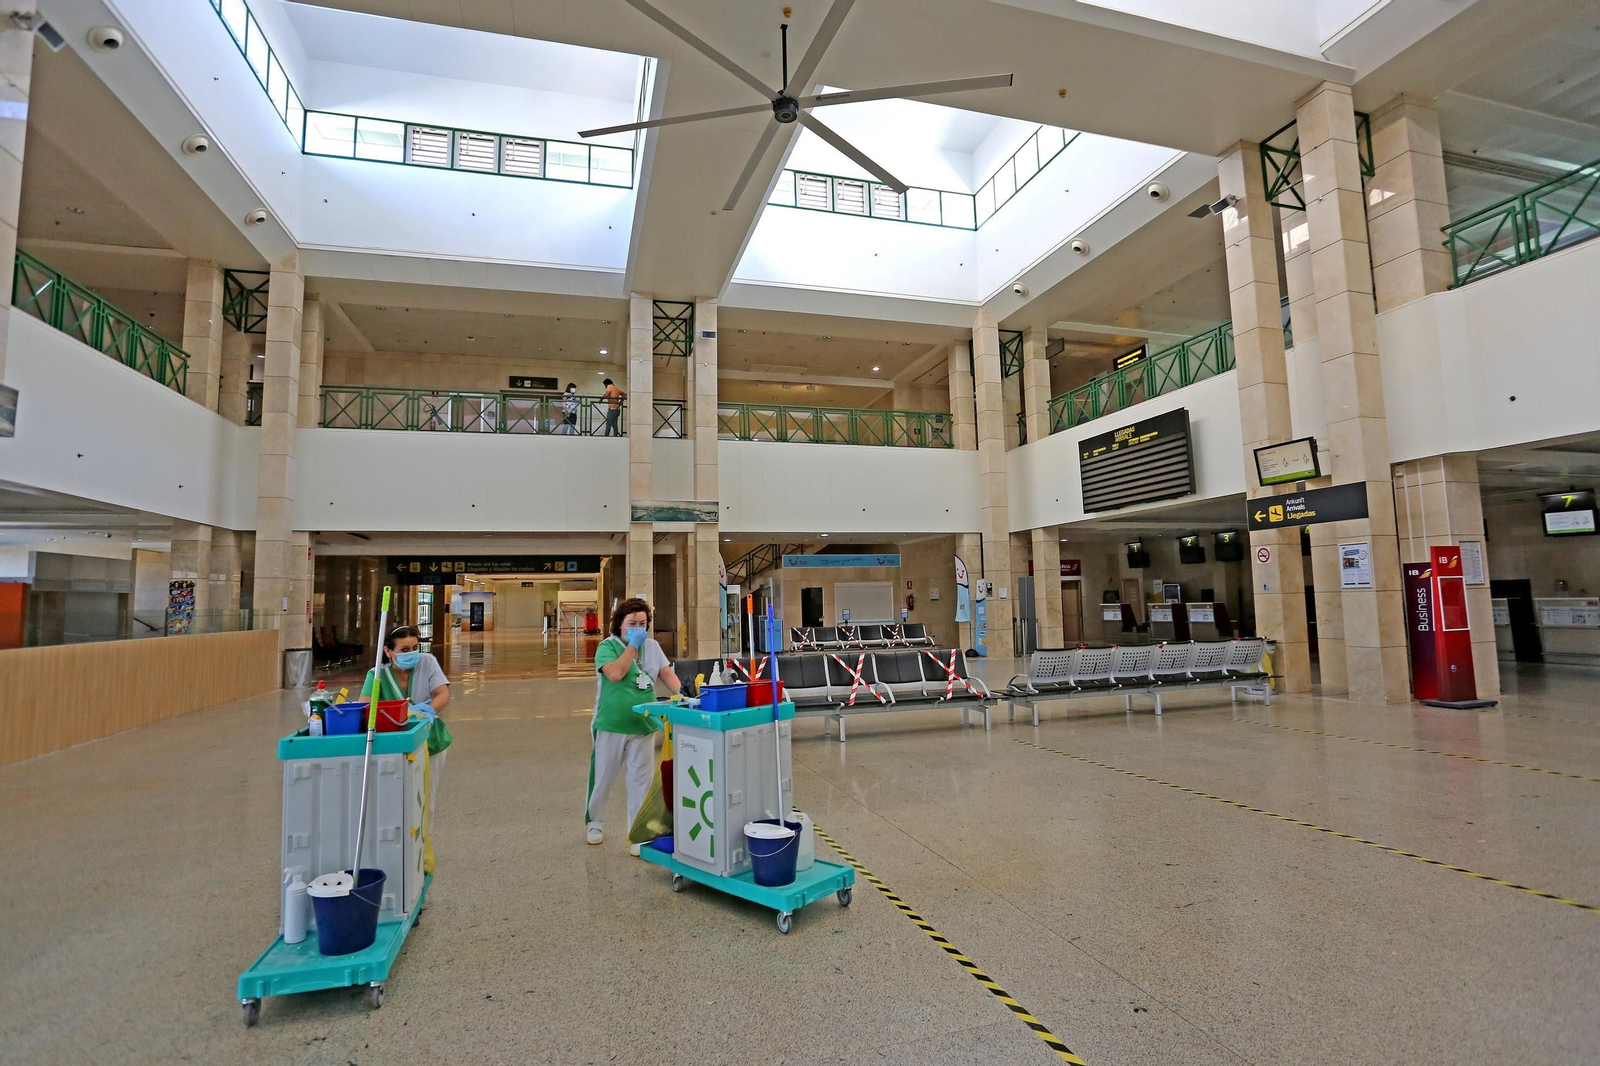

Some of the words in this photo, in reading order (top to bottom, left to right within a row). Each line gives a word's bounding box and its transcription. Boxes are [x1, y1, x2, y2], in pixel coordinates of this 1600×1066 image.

[1286, 497, 1305, 505] Ankunft
[1561, 495, 1573, 508] 7
[1286, 504, 1306, 512] Arrivals
[1287, 510, 1316, 520] Llegadas
[1186, 538, 1192, 547] 2
[1223, 534, 1230, 543] 3
[1133, 545, 1138, 553] 1
[1438, 556, 1448, 564] IB
[1416, 587, 1429, 632] Business
